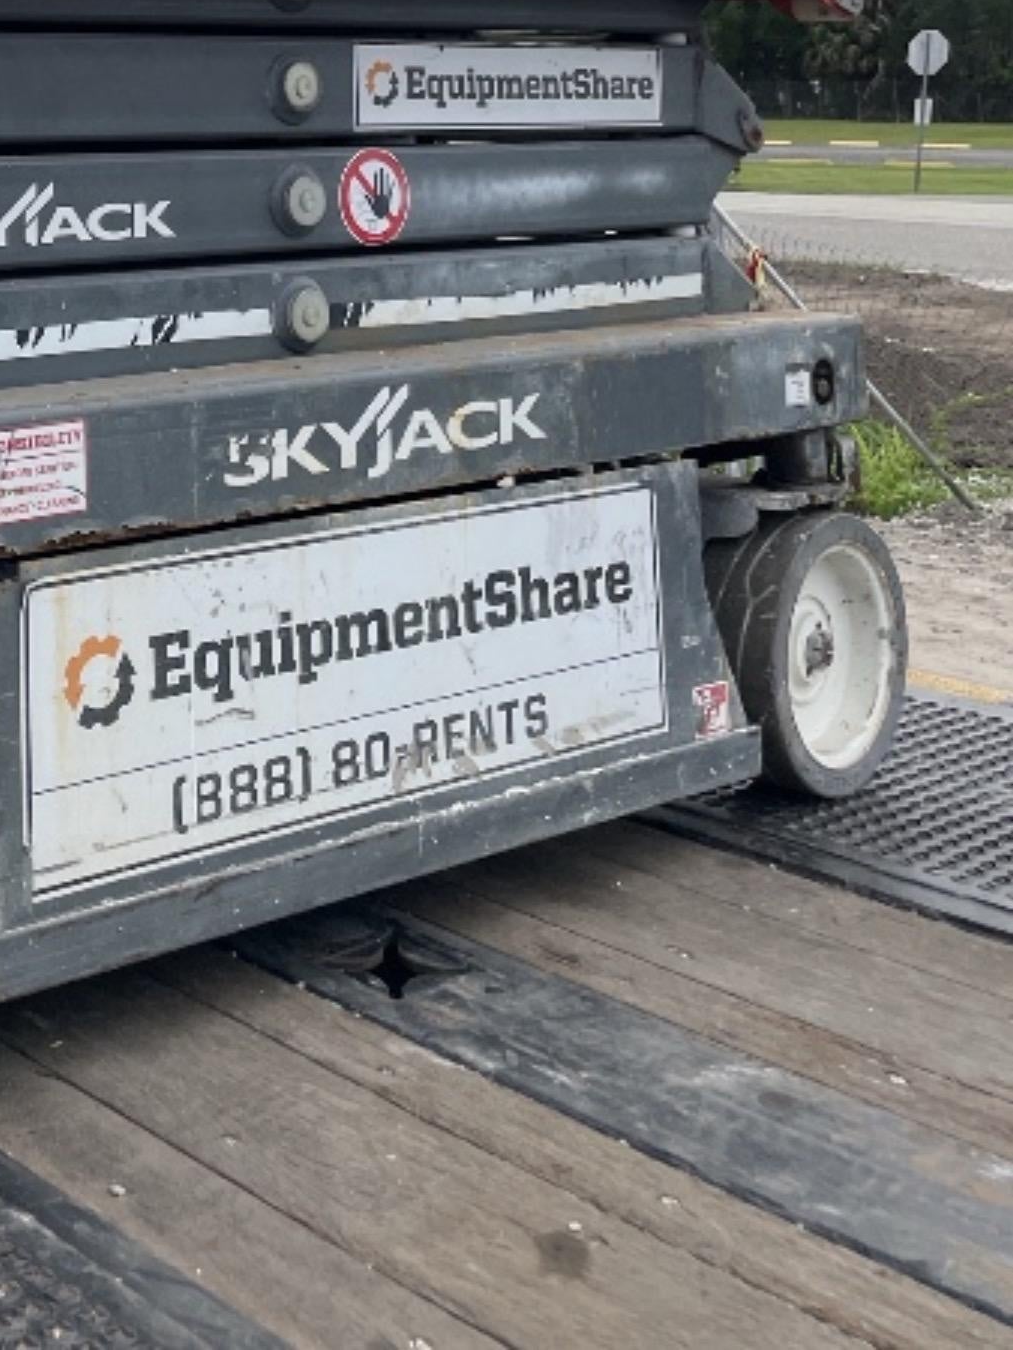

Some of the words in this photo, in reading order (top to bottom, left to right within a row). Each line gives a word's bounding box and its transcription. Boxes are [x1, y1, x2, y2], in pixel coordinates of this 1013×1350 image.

[405, 65, 655, 107] EquipmentShare
[223, 385, 546, 487] SKYJACK
[149, 561, 633, 702] EquipmentShare
[173, 747, 312, 834] (888)
[333, 694, 550, 786] 80-RENTS
